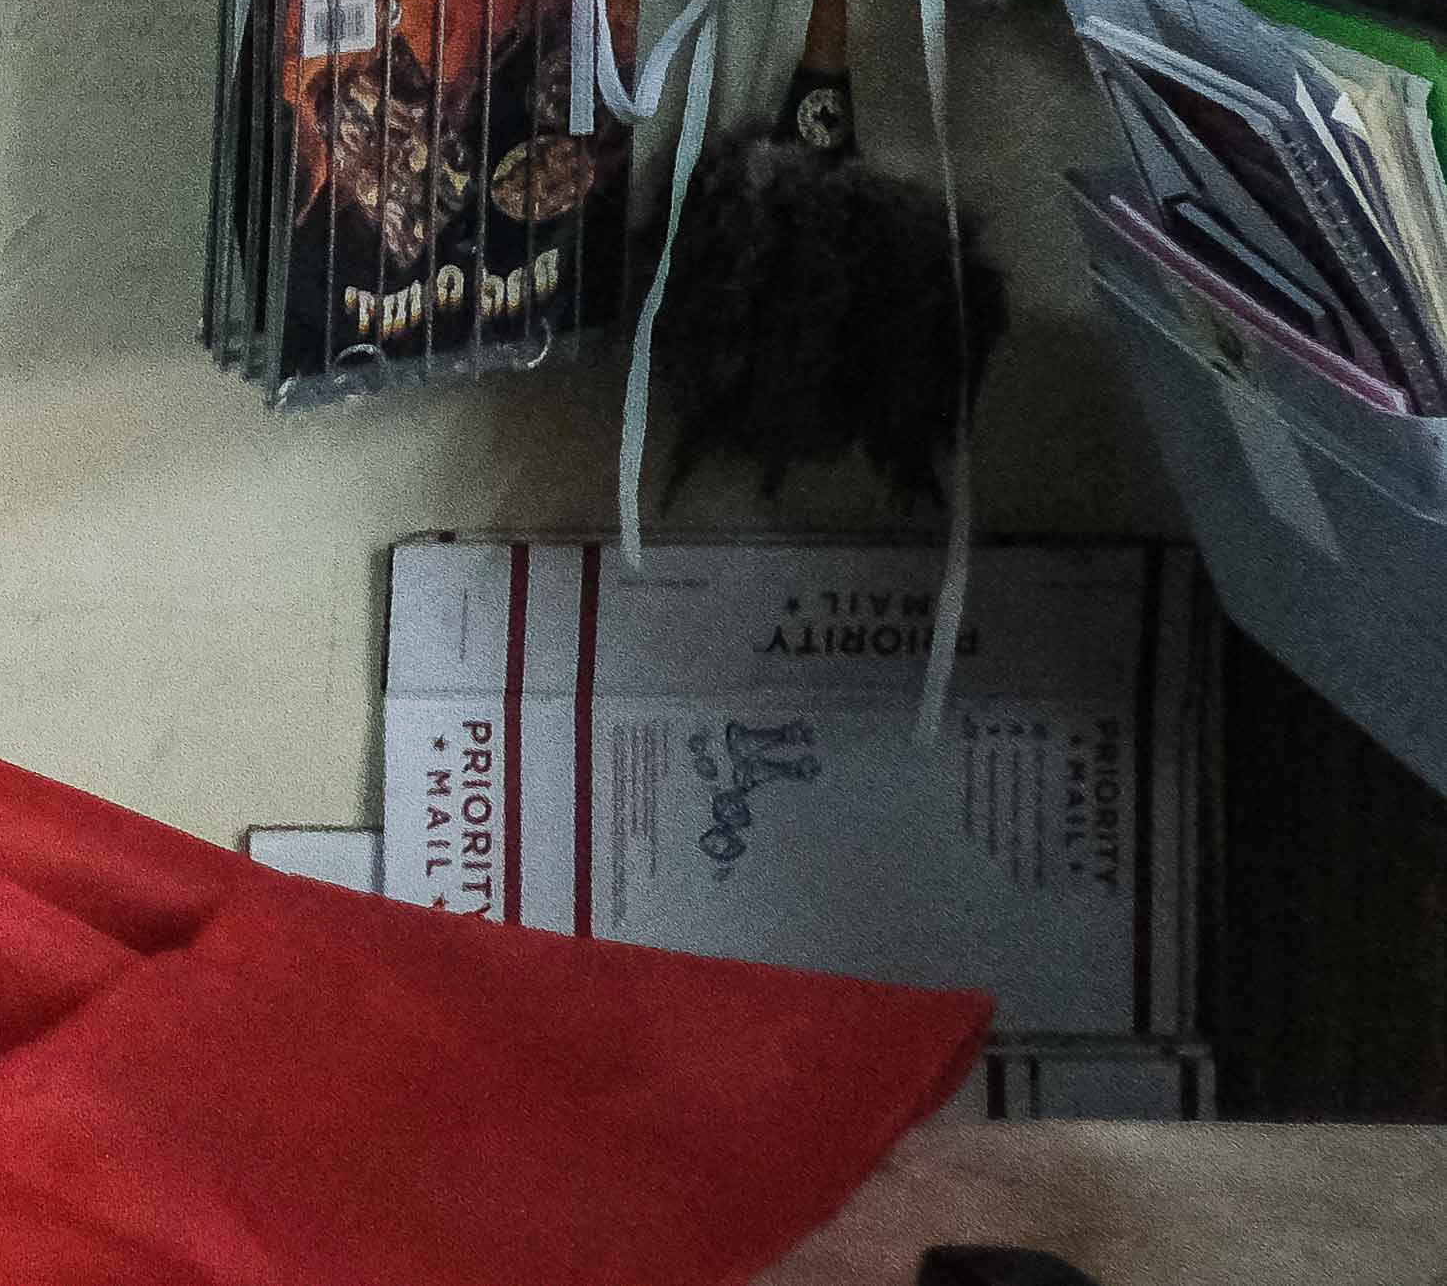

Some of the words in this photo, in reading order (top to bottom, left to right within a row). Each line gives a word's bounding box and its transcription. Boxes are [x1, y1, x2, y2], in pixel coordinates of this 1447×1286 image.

[766, 625, 979, 656] PIORITY
[821, 591, 931, 616] MAIL
[426, 769, 452, 877] MAIL
[1065, 759, 1086, 847] MAIL
[1094, 719, 1121, 886] PRIORITY
